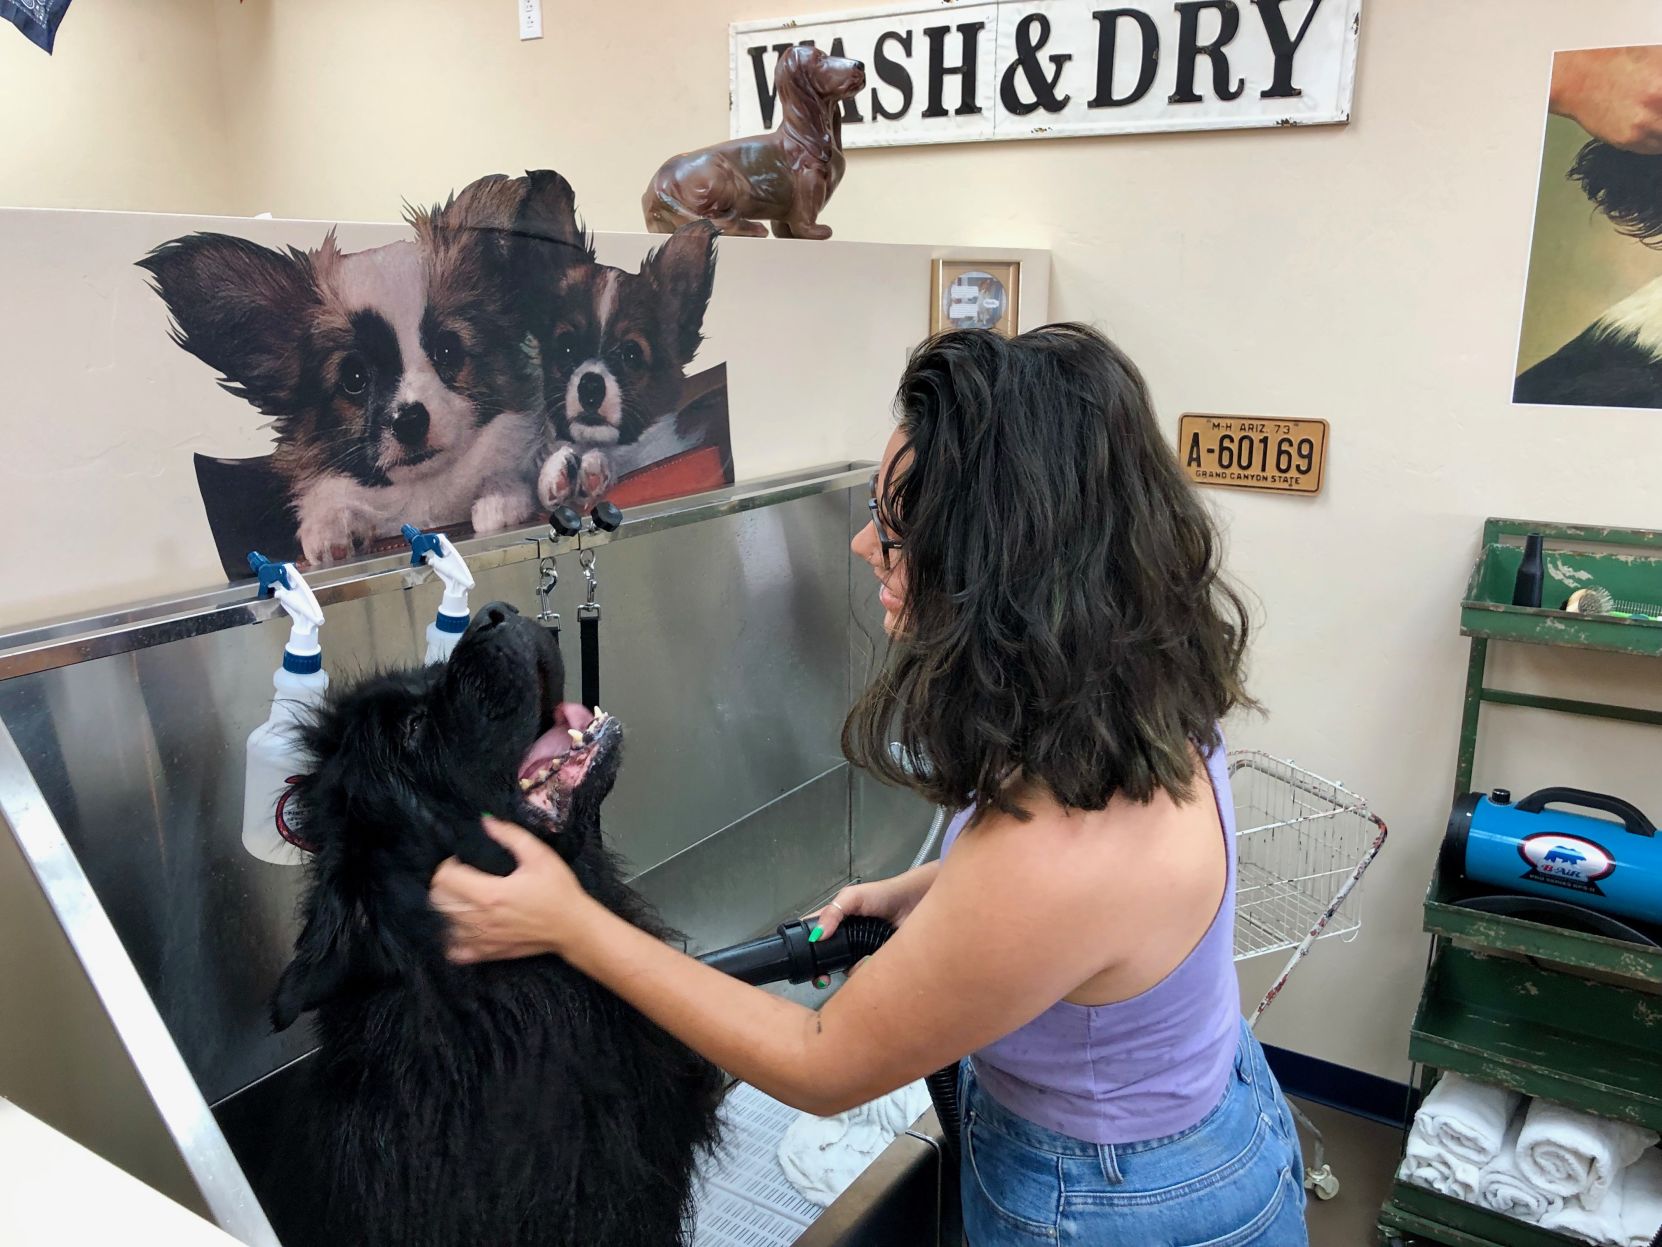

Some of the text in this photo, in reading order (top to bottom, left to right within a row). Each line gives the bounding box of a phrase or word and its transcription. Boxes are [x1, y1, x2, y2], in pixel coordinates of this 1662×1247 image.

[1000, 13, 1072, 116] &
[1087, 0, 1323, 109] DRY
[1211, 422, 1233, 431] M-H
[1273, 424, 1291, 434] 73
[1186, 431, 1315, 475] A-60169
[1195, 469, 1302, 486] GRAND CANYON STATE
